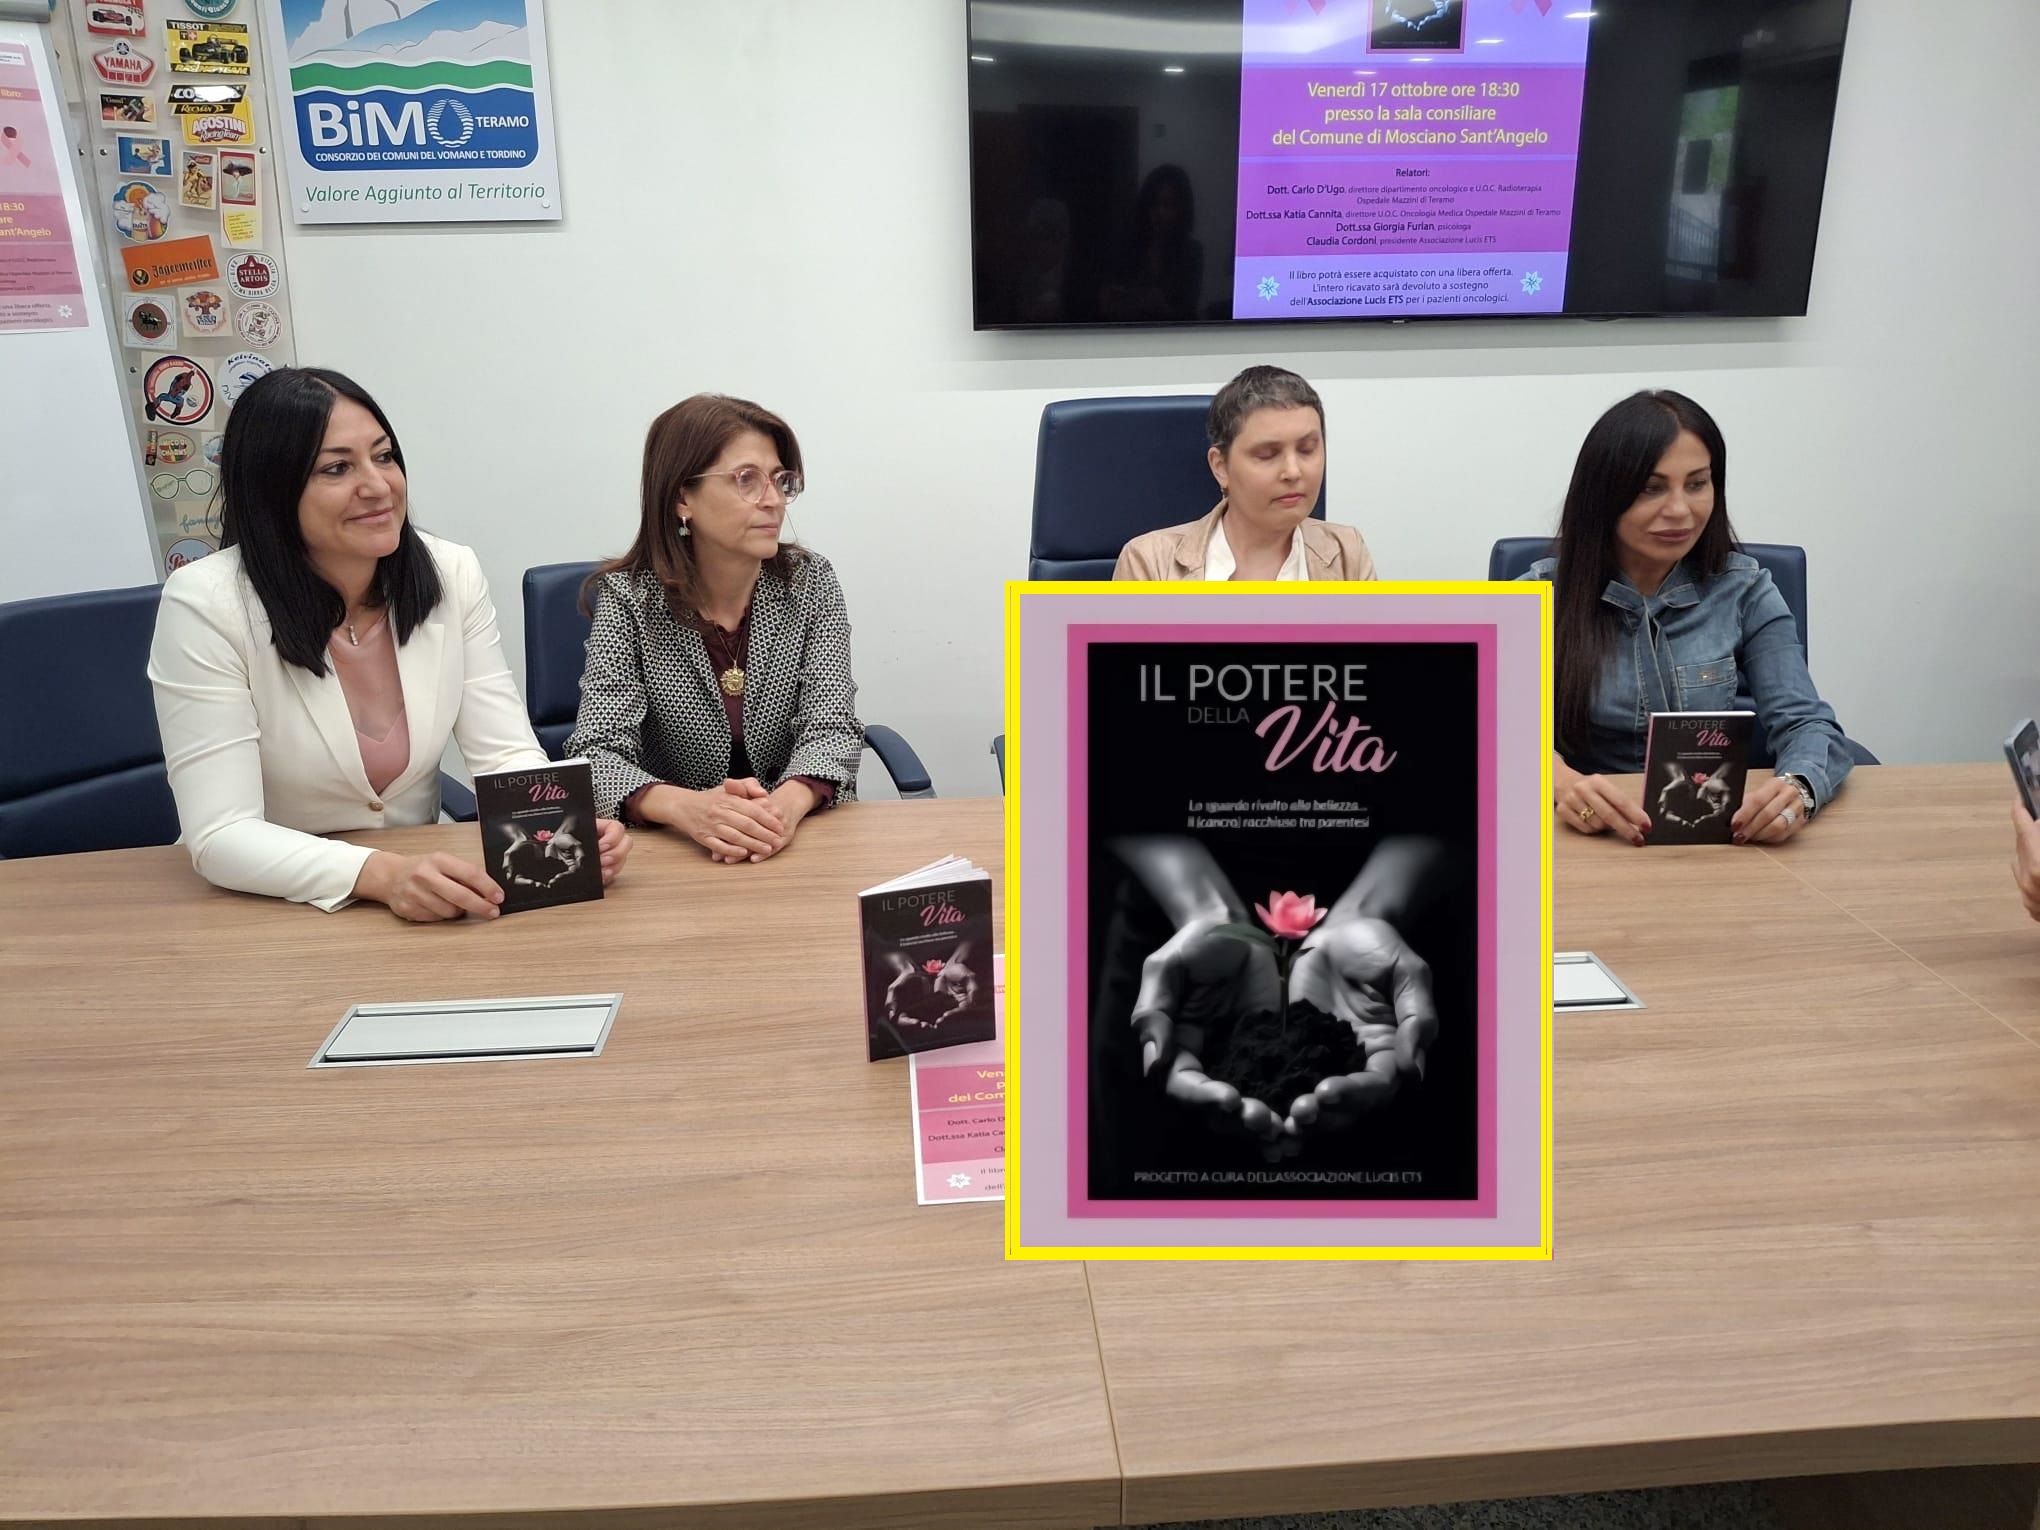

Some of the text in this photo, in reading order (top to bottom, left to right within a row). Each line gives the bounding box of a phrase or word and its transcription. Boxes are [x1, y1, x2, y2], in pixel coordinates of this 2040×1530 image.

[169, 22, 206, 31] TISSOT
[104, 56, 143, 70] YAMAHA
[1308, 81, 1520, 97] Venerdì 17 ottobre ore 18:30
[1325, 104, 1496, 124] presso la sala consiliare
[192, 116, 247, 134] AGOSTINI
[475, 116, 530, 128] TERAMO
[1272, 128, 1548, 148] del Comune di Mosciano Sant'Angelo
[315, 149, 527, 162] CONSORZIO DEI COMUNI DEL VOMANO E TORDINO
[1395, 168, 1431, 177] Relatori:
[306, 182, 545, 204] Valore Aggiunto al Territorio
[1267, 185, 1289, 195] Dott.
[1292, 184, 1315, 194] Carlo
[1348, 186, 1380, 194] direttore
[1381, 185, 1427, 194] dipartimento
[1429, 184, 1468, 194] oncologico
[1498, 184, 1542, 193] Radioterapia
[1357, 196, 1455, 205] Ospedale Mazzini di Teramo
[1284, 210, 1306, 219] Katia
[1346, 210, 1376, 218] direttore
[1400, 210, 1436, 218] Oncologia
[1438, 209, 1463, 217] Medica
[1465, 209, 1498, 218] Ospedale
[1500, 208, 1526, 216] Mazzini
[1528, 208, 1534, 216] di
[1536, 208, 1561, 216] Teramo
[1373, 222, 1405, 232] Giorgia
[1438, 224, 1472, 232] psicologa
[0, 228, 52, 240] ant'Angelo
[1306, 236, 1340, 246] Claudia
[1420, 236, 1464, 244] Associazione
[1465, 236, 1482, 244] Lucis
[1289, 271, 1295, 280] Il
[1296, 271, 1316, 280] libro
[1318, 270, 1342, 281] potrà
[1344, 271, 1371, 279] essere
[1373, 269, 1418, 280] acquistato
[1420, 270, 1436, 278] con
[1457, 268, 1480, 277] libera
[1482, 267, 1513, 276] offerta.
[1312, 284, 1344, 292] L'intero
[1346, 284, 1380, 292] ricavato
[1382, 282, 1400, 291] sarà
[1402, 282, 1440, 290] devoluto
[1450, 281, 1489, 292] sostegno
[1364, 296, 1386, 305] Lucis
[1388, 295, 1404, 304] ETS
[1406, 296, 1420, 306] per
[1427, 294, 1461, 304] pazienti
[1668, 720, 1727, 730] IL POTERE
[1696, 729, 1732, 746] Vita
[494, 772, 560, 790] IL POTERE
[528, 782, 570, 802] Vita
[882, 890, 956, 912] IL POTERE
[920, 902, 966, 927] Vita
[948, 1092, 1005, 1103] del Com
[947, 1118, 970, 1127] Dott.
[972, 1117, 996, 1126] Carlo
[967, 1130, 990, 1139] Katia
